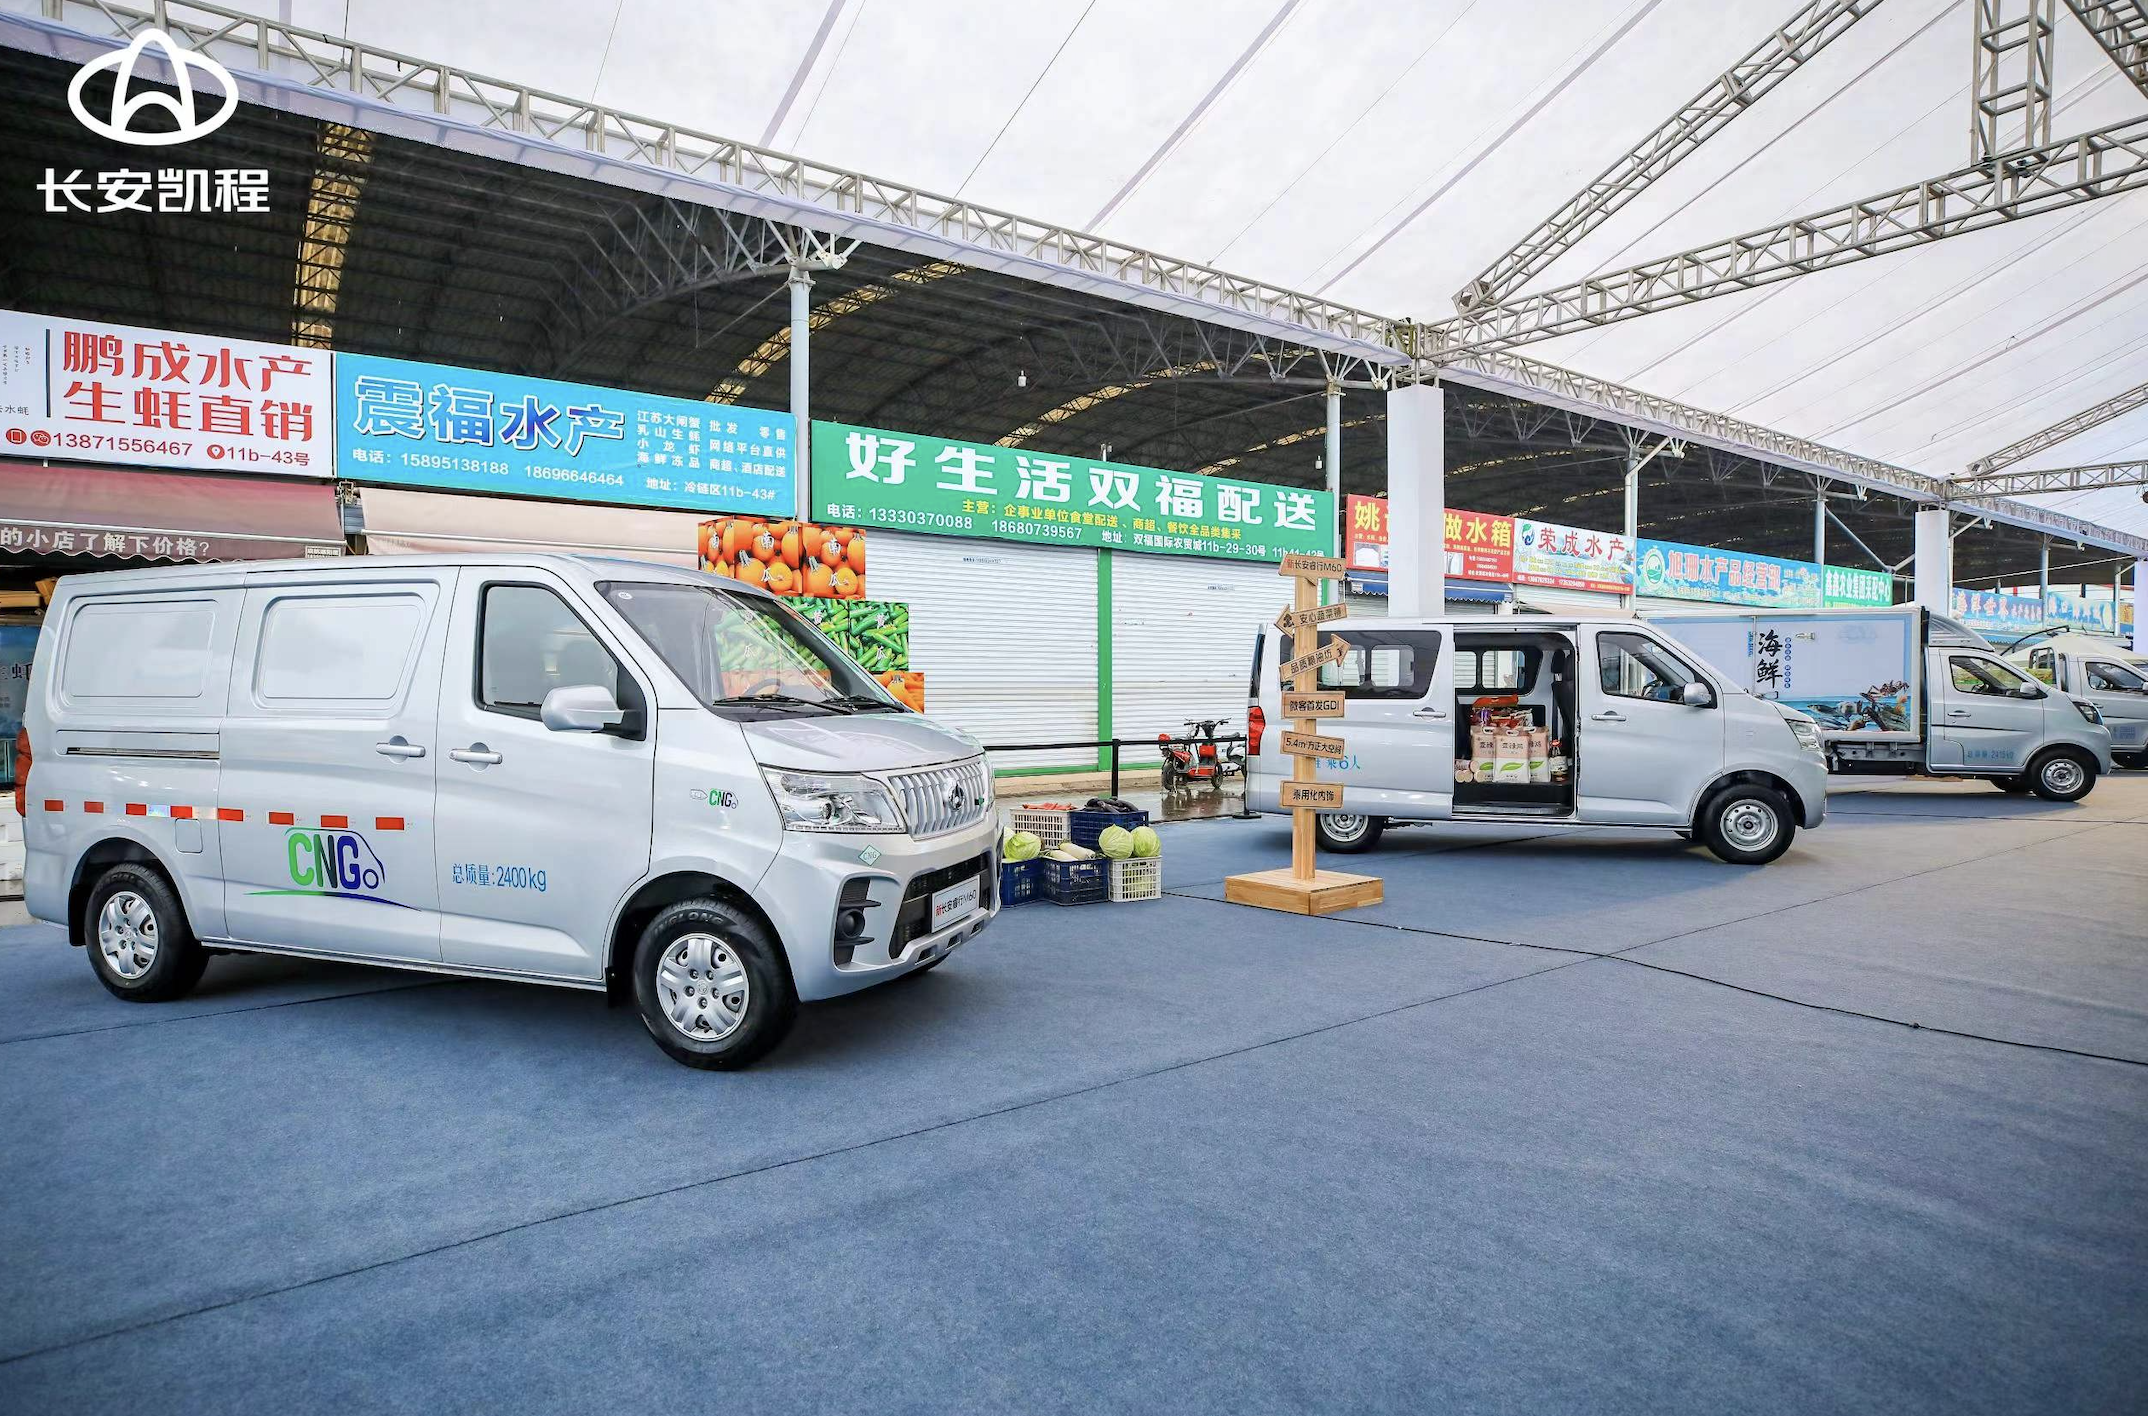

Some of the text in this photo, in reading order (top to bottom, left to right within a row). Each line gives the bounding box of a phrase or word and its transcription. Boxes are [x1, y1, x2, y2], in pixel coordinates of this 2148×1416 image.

[63, 331, 313, 392] 鹏成水产
[63, 381, 313, 442] 生蚝直销
[353, 375, 625, 458] 震福水产
[637, 410, 700, 428] 江苏大闸蟹
[637, 424, 700, 441] 乳山生蚝
[637, 438, 700, 455] 小龙虾
[709, 420, 786, 441] 批发 零售
[54, 432, 311, 467] 13871556467 11b-43号
[637, 451, 700, 469] 海鲜冻品
[709, 439, 786, 459] 网络平台直供
[401, 454, 508, 475] 15895138188
[524, 466, 623, 487] 18696646464
[845, 431, 1317, 531] 好生活双福配送
[869, 507, 973, 529] 13330370088
[991, 519, 1083, 540] 18680739567
[1354, 500, 1388, 532] 姚
[1537, 527, 1626, 561] 荣成水产
[1756, 629, 1783, 688] 海鲜
[709, 789, 733, 808] CNG
[288, 833, 361, 890] CNG
